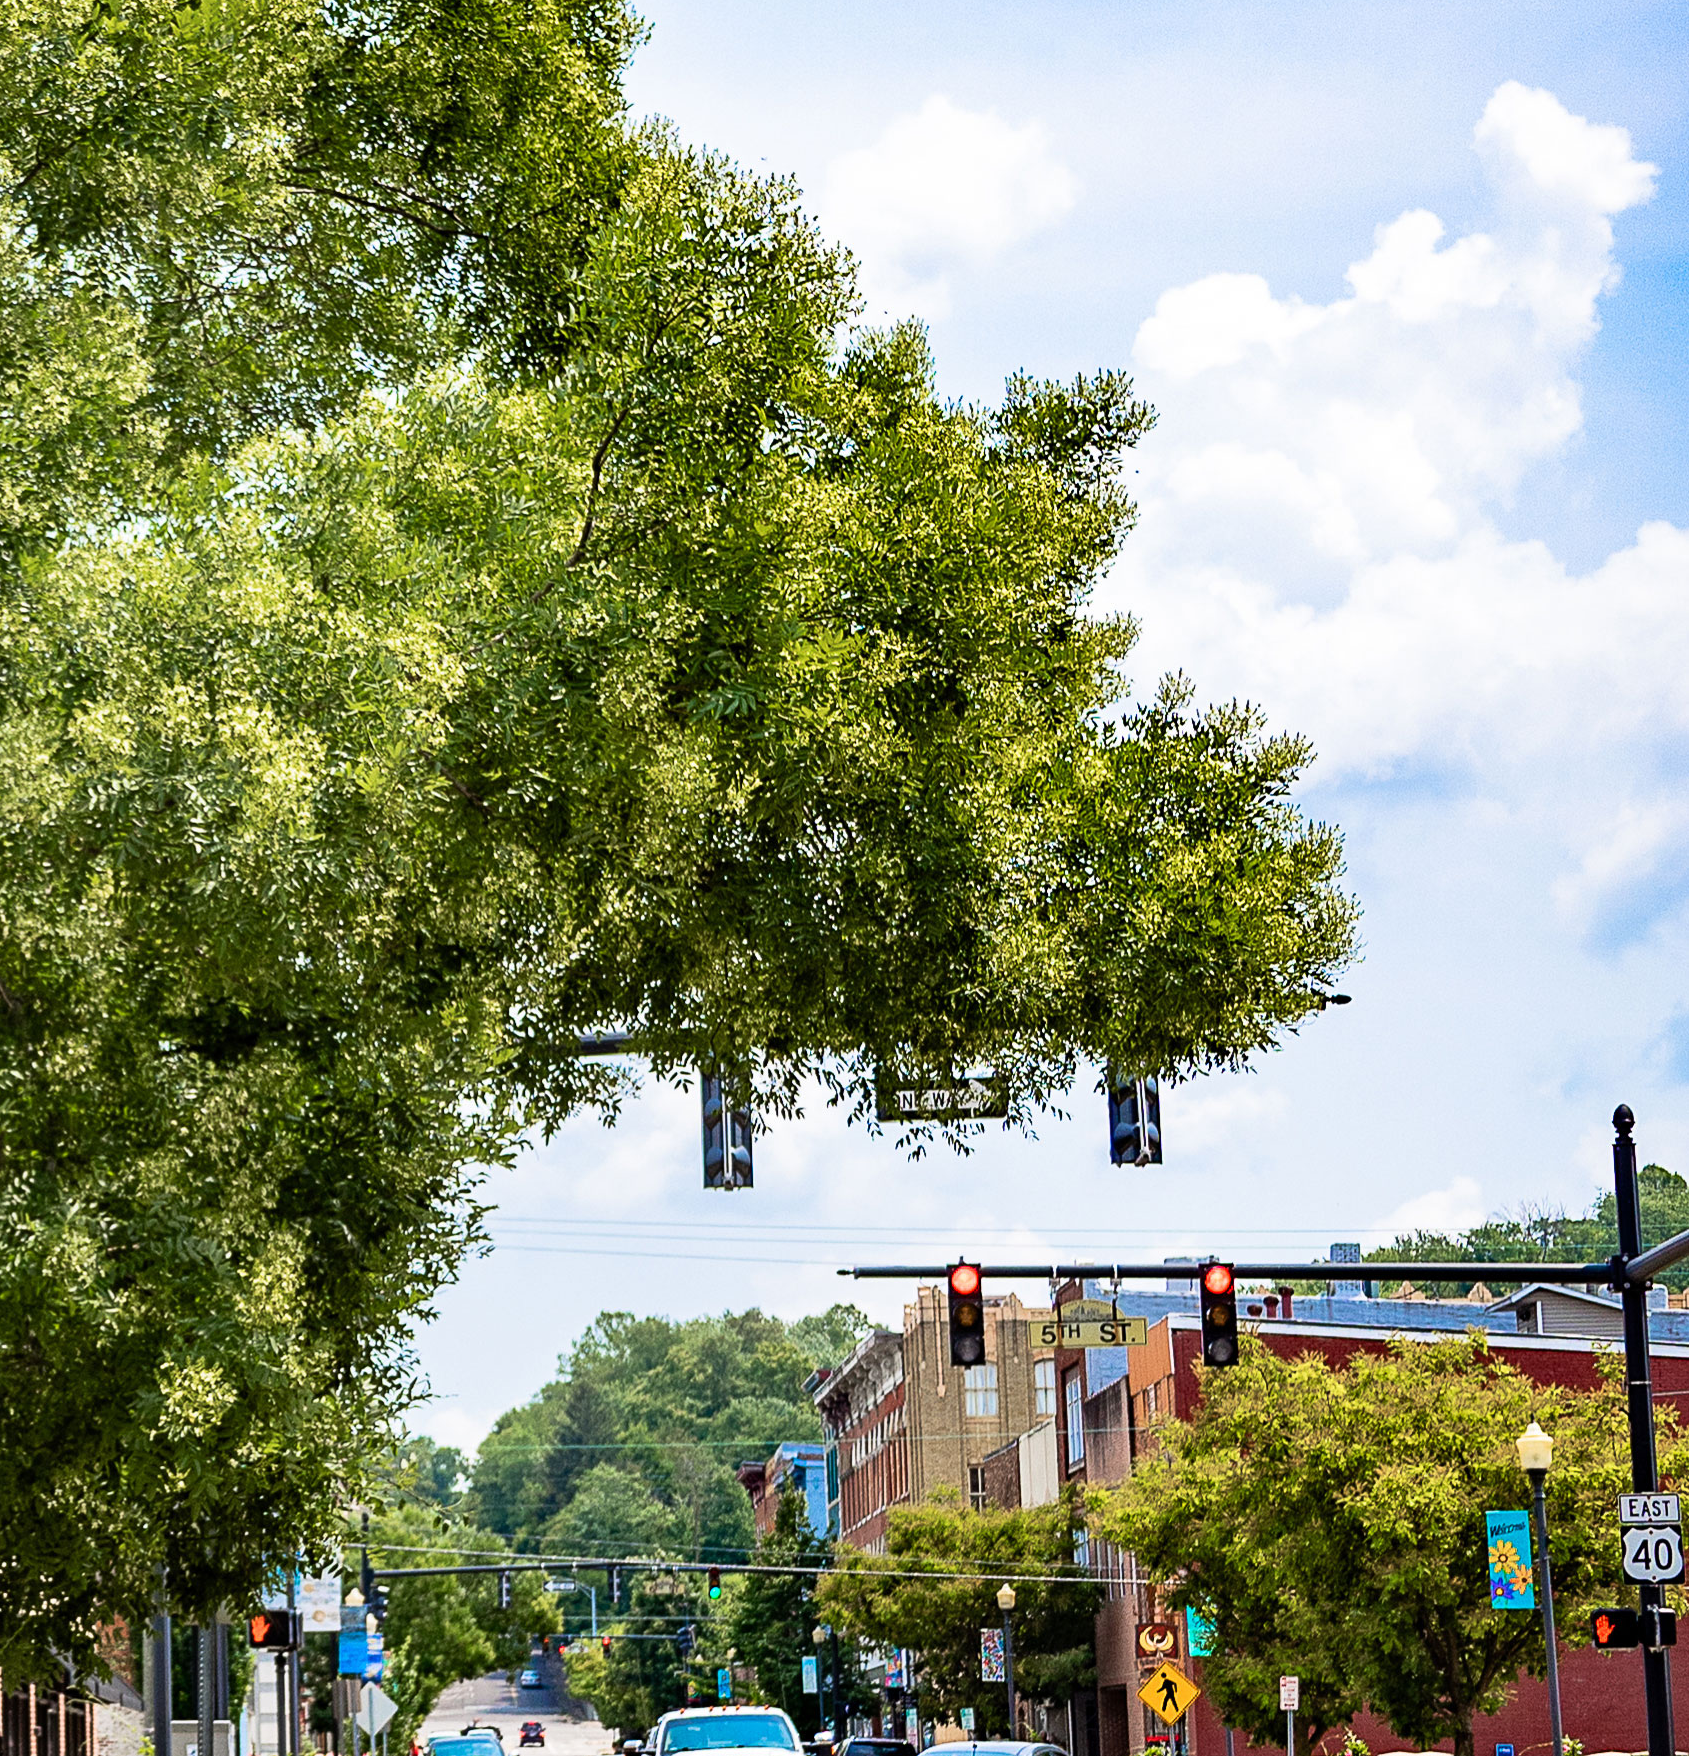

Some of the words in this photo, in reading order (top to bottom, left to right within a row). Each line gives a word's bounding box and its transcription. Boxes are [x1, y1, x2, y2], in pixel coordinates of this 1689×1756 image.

[1041, 1324, 1081, 1344] 5TH
[1099, 1323, 1136, 1343] ST.
[1628, 1498, 1671, 1517] EAST
[1632, 1538, 1673, 1571] 40
